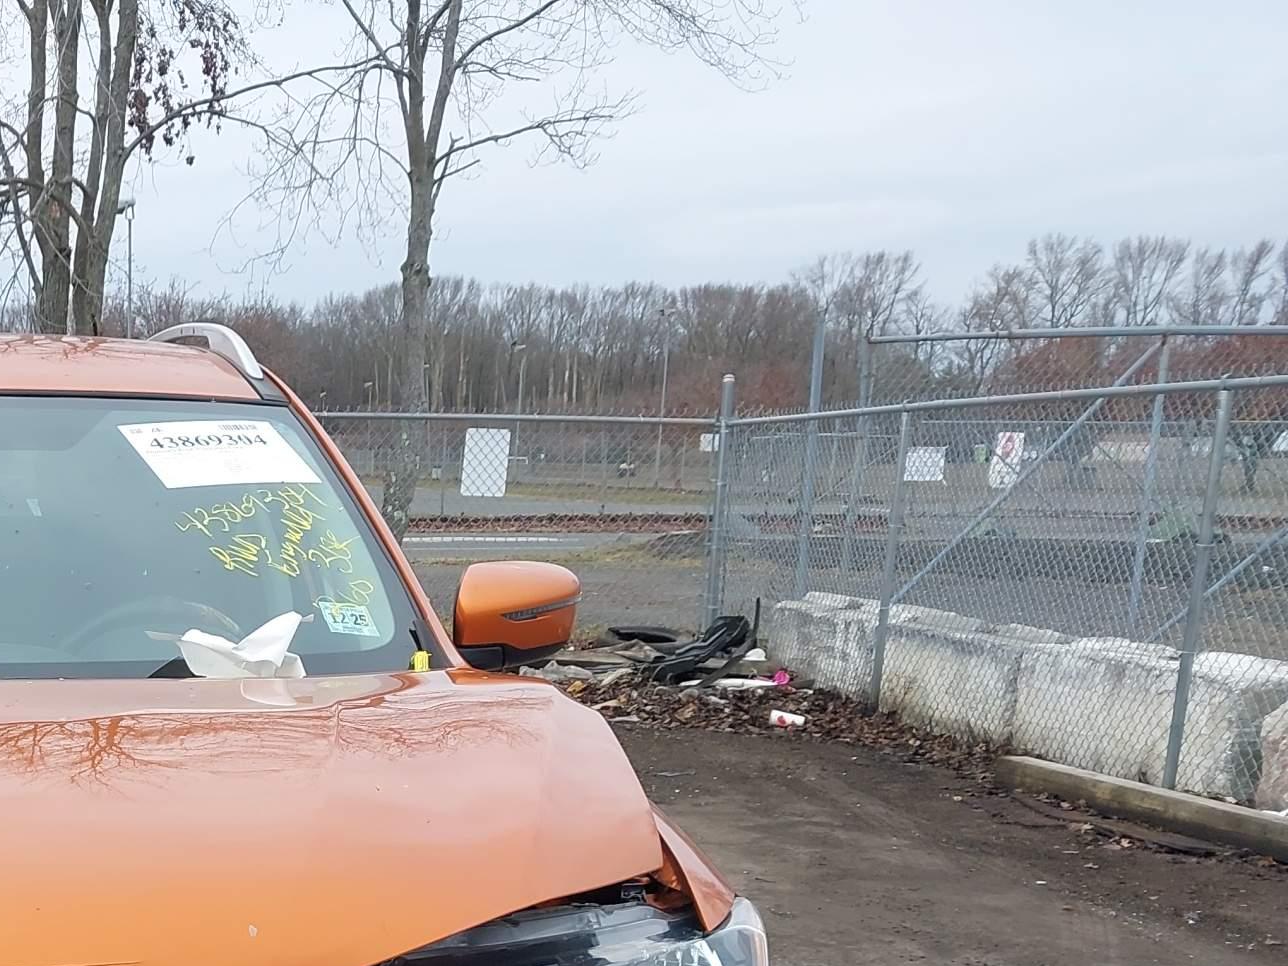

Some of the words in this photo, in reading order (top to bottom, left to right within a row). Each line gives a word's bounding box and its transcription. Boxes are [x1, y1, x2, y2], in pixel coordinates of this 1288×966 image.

[150, 434, 268, 449] 43869304
[328, 612, 349, 624] 12
[350, 613, 369, 626] 25
